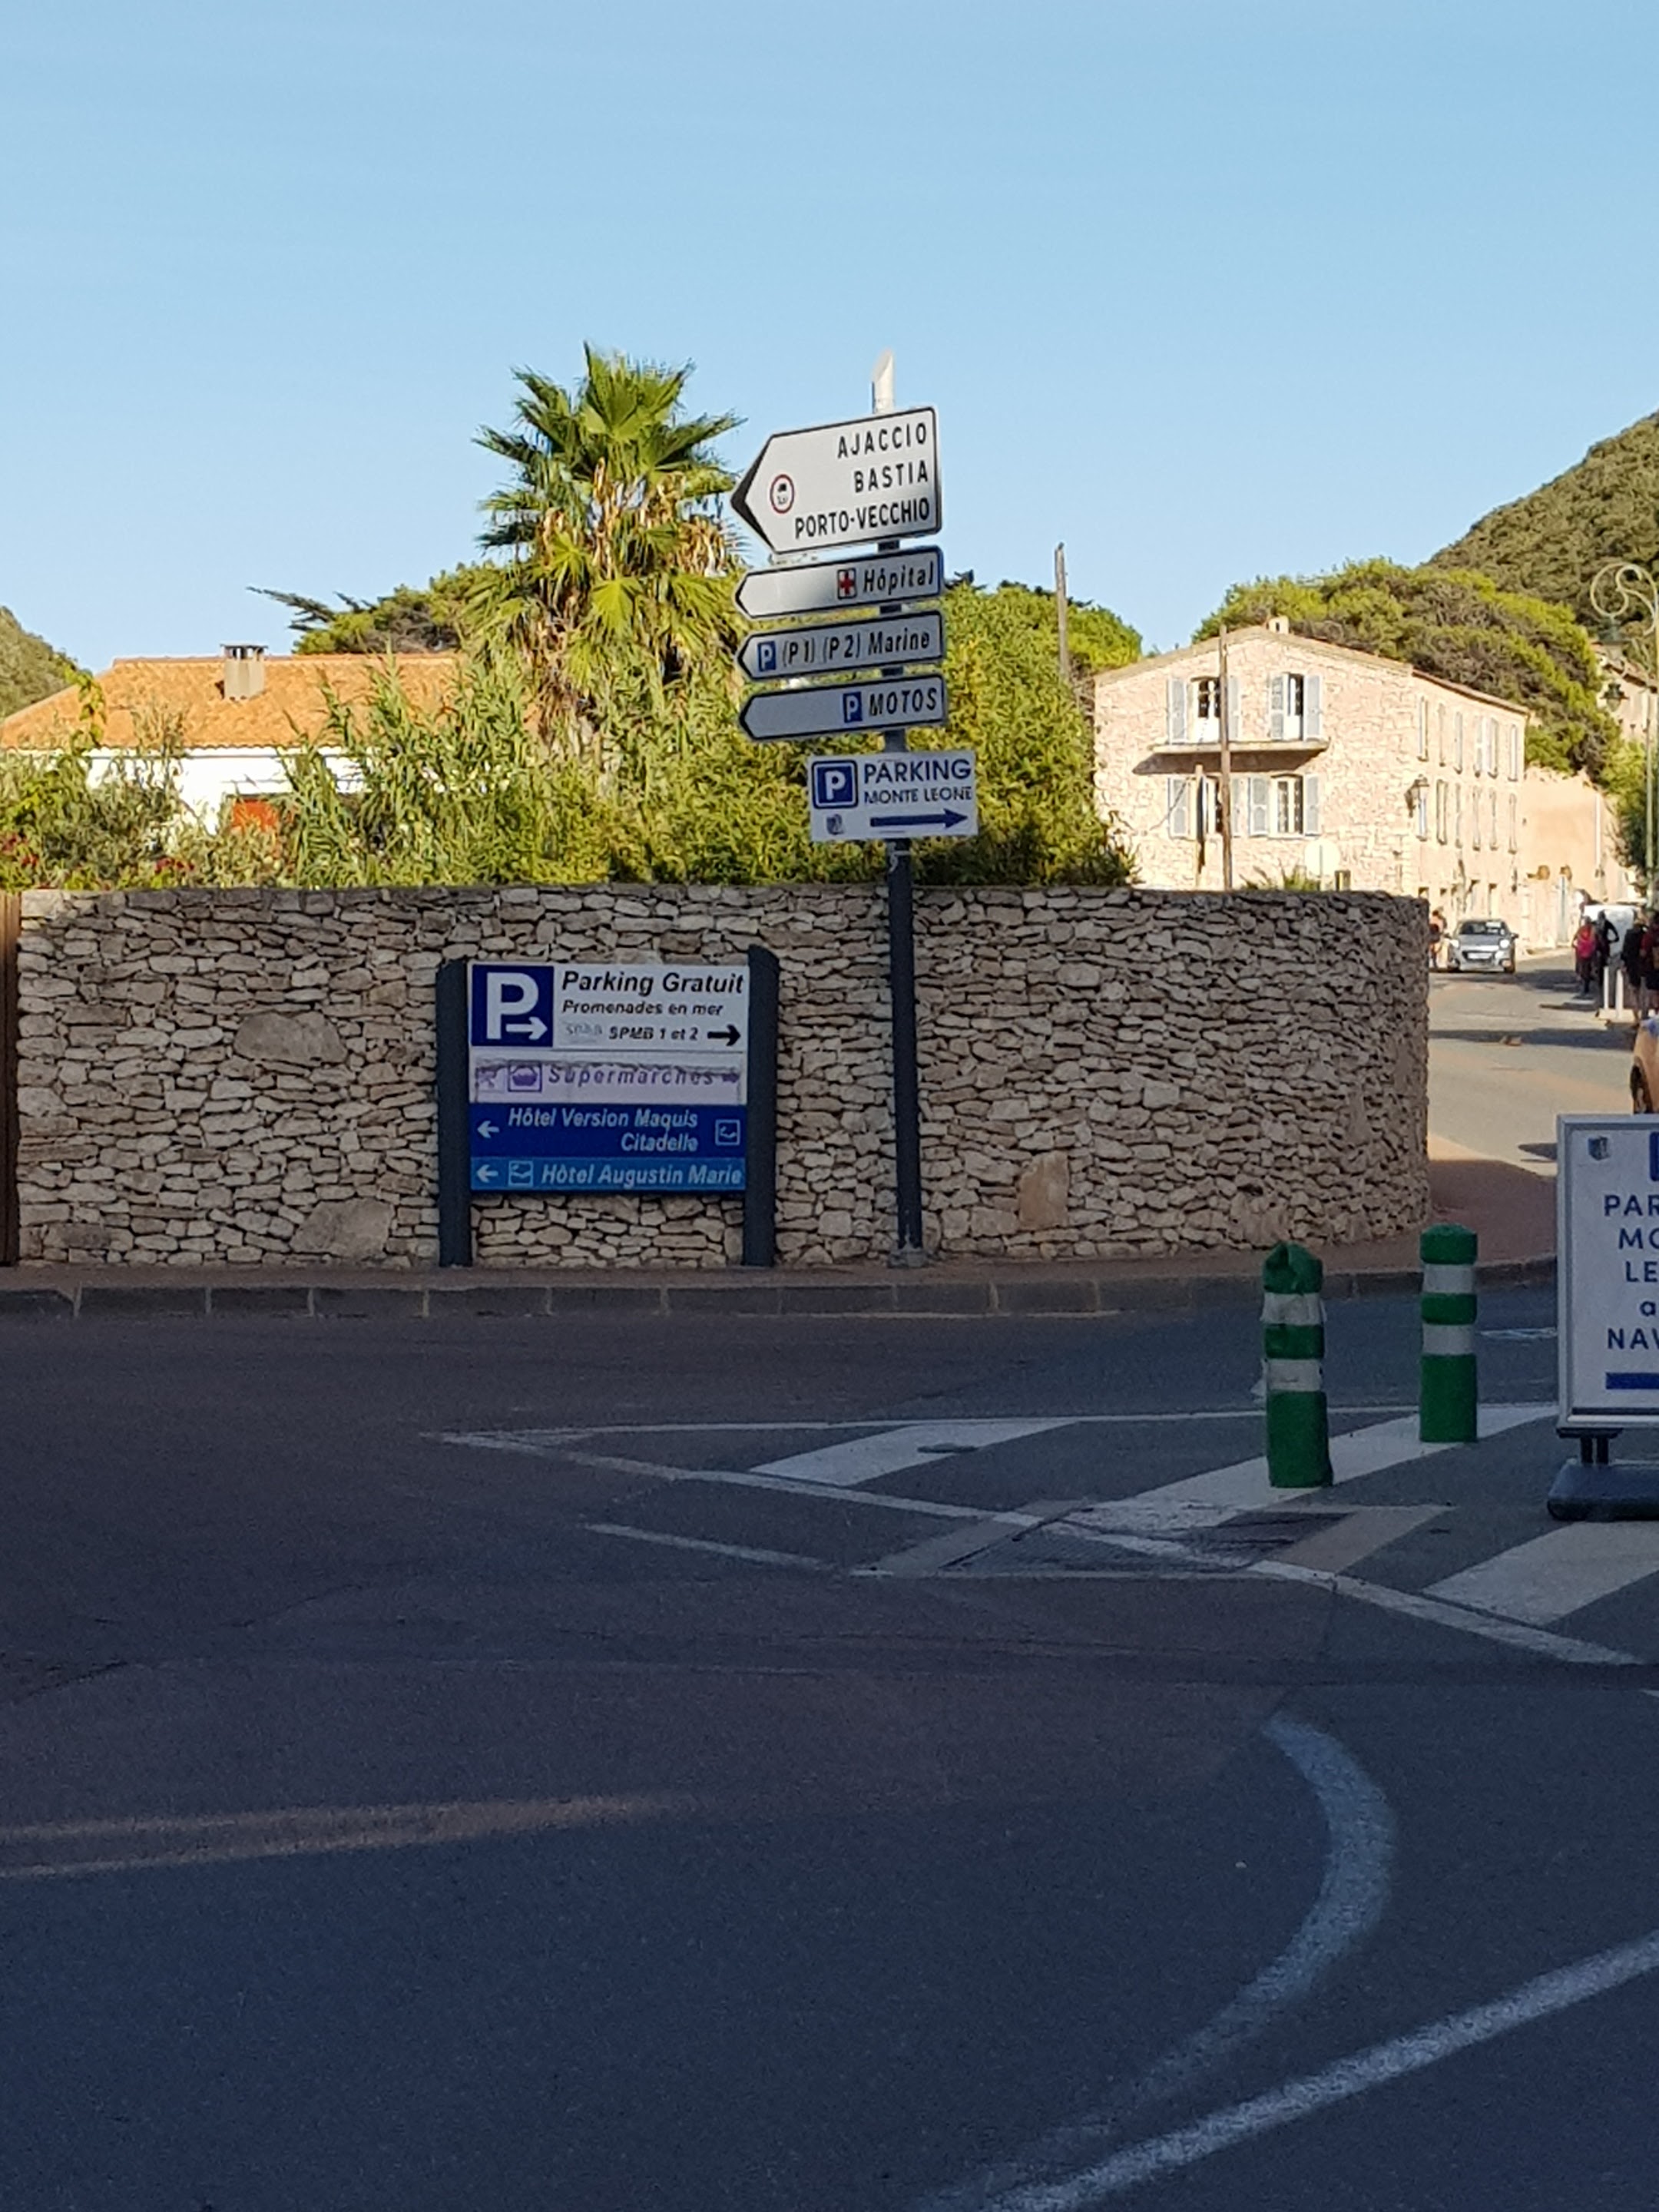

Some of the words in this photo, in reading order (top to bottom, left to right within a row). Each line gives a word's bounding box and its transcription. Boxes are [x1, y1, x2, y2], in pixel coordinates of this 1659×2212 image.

[837, 422, 927, 459] AJACCIO
[854, 459, 929, 493] BASTIA
[795, 497, 930, 539] PORTO-VECCHIO
[863, 561, 935, 595] Hôpital
[759, 643, 773, 671] P
[868, 628, 930, 655] Marine
[846, 694, 859, 720] P
[869, 687, 938, 716] MOTOS
[825, 770, 846, 800] P
[864, 759, 972, 784] PARKING
[864, 789, 919, 803] MONTE
[924, 786, 972, 802] LEONE
[561, 970, 654, 997] Parking
[663, 972, 744, 994] Gratuit
[486, 972, 539, 1039] P
[561, 999, 663, 1015] Promenades
[668, 1004, 687, 1015] en
[692, 1005, 724, 1016] mer
[660, 1028, 667, 1040] 1
[671, 1028, 687, 1040] et
[689, 1027, 699, 1040] 2
[508, 1108, 556, 1128] Hôtel
[561, 1108, 629, 1128] Version
[634, 1108, 698, 1133] Maquis
[621, 1132, 699, 1152] Citadelle
[541, 1164, 595, 1184] Hôtel
[598, 1165, 684, 1190] Augustin
[688, 1164, 743, 1185] Marie
[1625, 1261, 1658, 1283] LE
